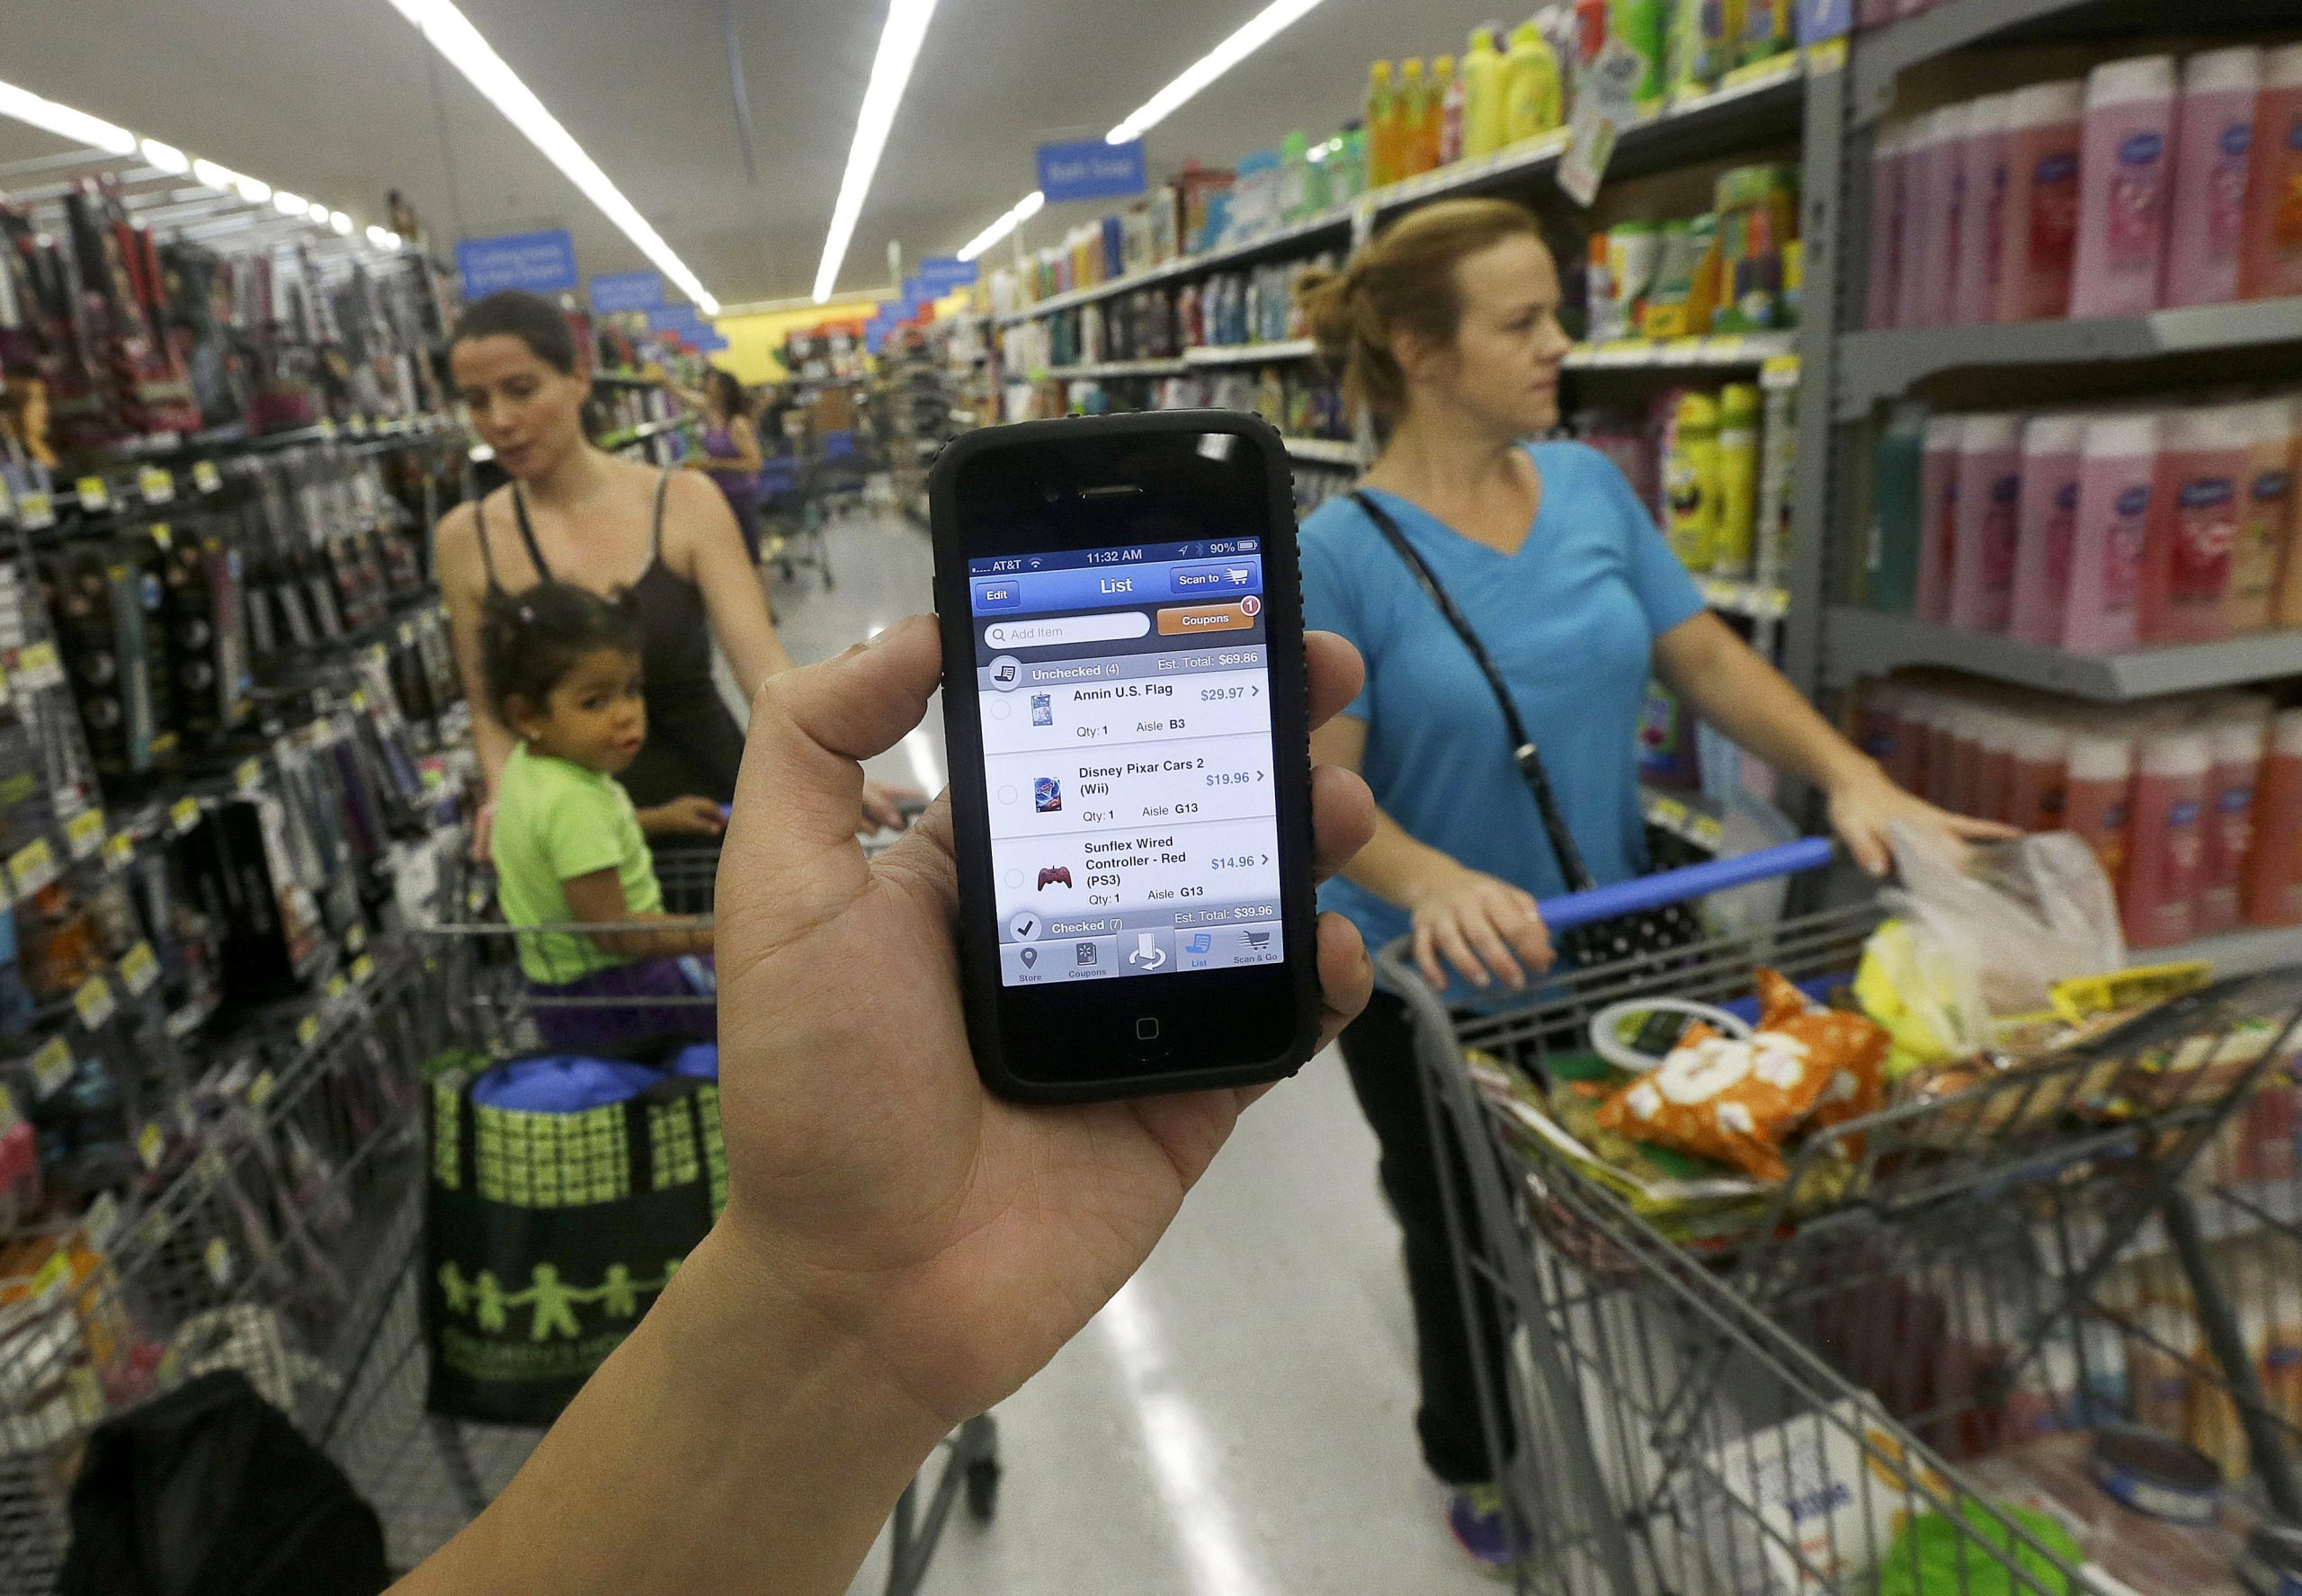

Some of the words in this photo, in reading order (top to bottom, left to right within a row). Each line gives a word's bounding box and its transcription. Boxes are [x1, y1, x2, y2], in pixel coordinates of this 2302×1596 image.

[1210, 542, 1235, 553] 90%
[1086, 550, 1119, 563] 11:32
[1121, 548, 1142, 560] AM
[993, 559, 1022, 571] AT&T
[1101, 577, 1132, 593] List
[1179, 574, 1205, 585] Scan
[1208, 573, 1219, 583] to
[986, 590, 1007, 601] Edit
[1245, 601, 1254, 611] 1
[1182, 613, 1229, 627] Coupons
[1011, 628, 1034, 639] Add
[1038, 626, 1063, 638] Item
[1158, 658, 1179, 670] Est.
[1182, 655, 1214, 667] Total:
[1218, 652, 1258, 665] $69.86
[1032, 665, 1101, 680] Unchecked
[1105, 663, 1120, 676] (4)
[1074, 689, 1111, 701] Annin
[1115, 686, 1141, 698] U.S.
[1146, 684, 1173, 699] Flag
[1200, 687, 1244, 701] $29.97
[1076, 727, 1100, 739] Qty:
[1102, 726, 1108, 736] 1
[1136, 721, 1163, 732] Aisle
[1169, 719, 1185, 730] B3
[1079, 765, 1122, 779] Disney
[1127, 762, 1159, 774] Pixar
[1164, 760, 1193, 771] Cars
[1197, 758, 1204, 768] 2
[1206, 772, 1249, 786] $19.96
[1080, 783, 1109, 798] (Wii)
[1142, 806, 1168, 816] Aisle
[1175, 803, 1198, 815] G13
[1083, 811, 1106, 824] Qty:
[1109, 810, 1114, 819] 1
[1085, 840, 1132, 853] Sunflex
[1137, 837, 1173, 850] Wired
[1085, 856, 1149, 870] Controller
[1162, 852, 1186, 864] Red
[1211, 855, 1254, 869] $14.96
[1087, 874, 1120, 888] (PS3)
[1089, 895, 1112, 906] Qty:
[1114, 894, 1120, 903] 1
[1147, 888, 1174, 900] Aisle
[1181, 887, 1203, 897] G13
[1174, 912, 1196, 923] Est.
[1199, 909, 1230, 921] Total:
[1235, 905, 1272, 919] $39.96
[1051, 920, 1104, 933] Checked
[1109, 918, 1123, 931] (7)
[1191, 958, 1207, 967] List
[1234, 955, 1255, 964] Scan
[1266, 953, 1277, 961] Go
[1019, 974, 1041, 982] Store
[1068, 969, 1107, 978] Coupons
